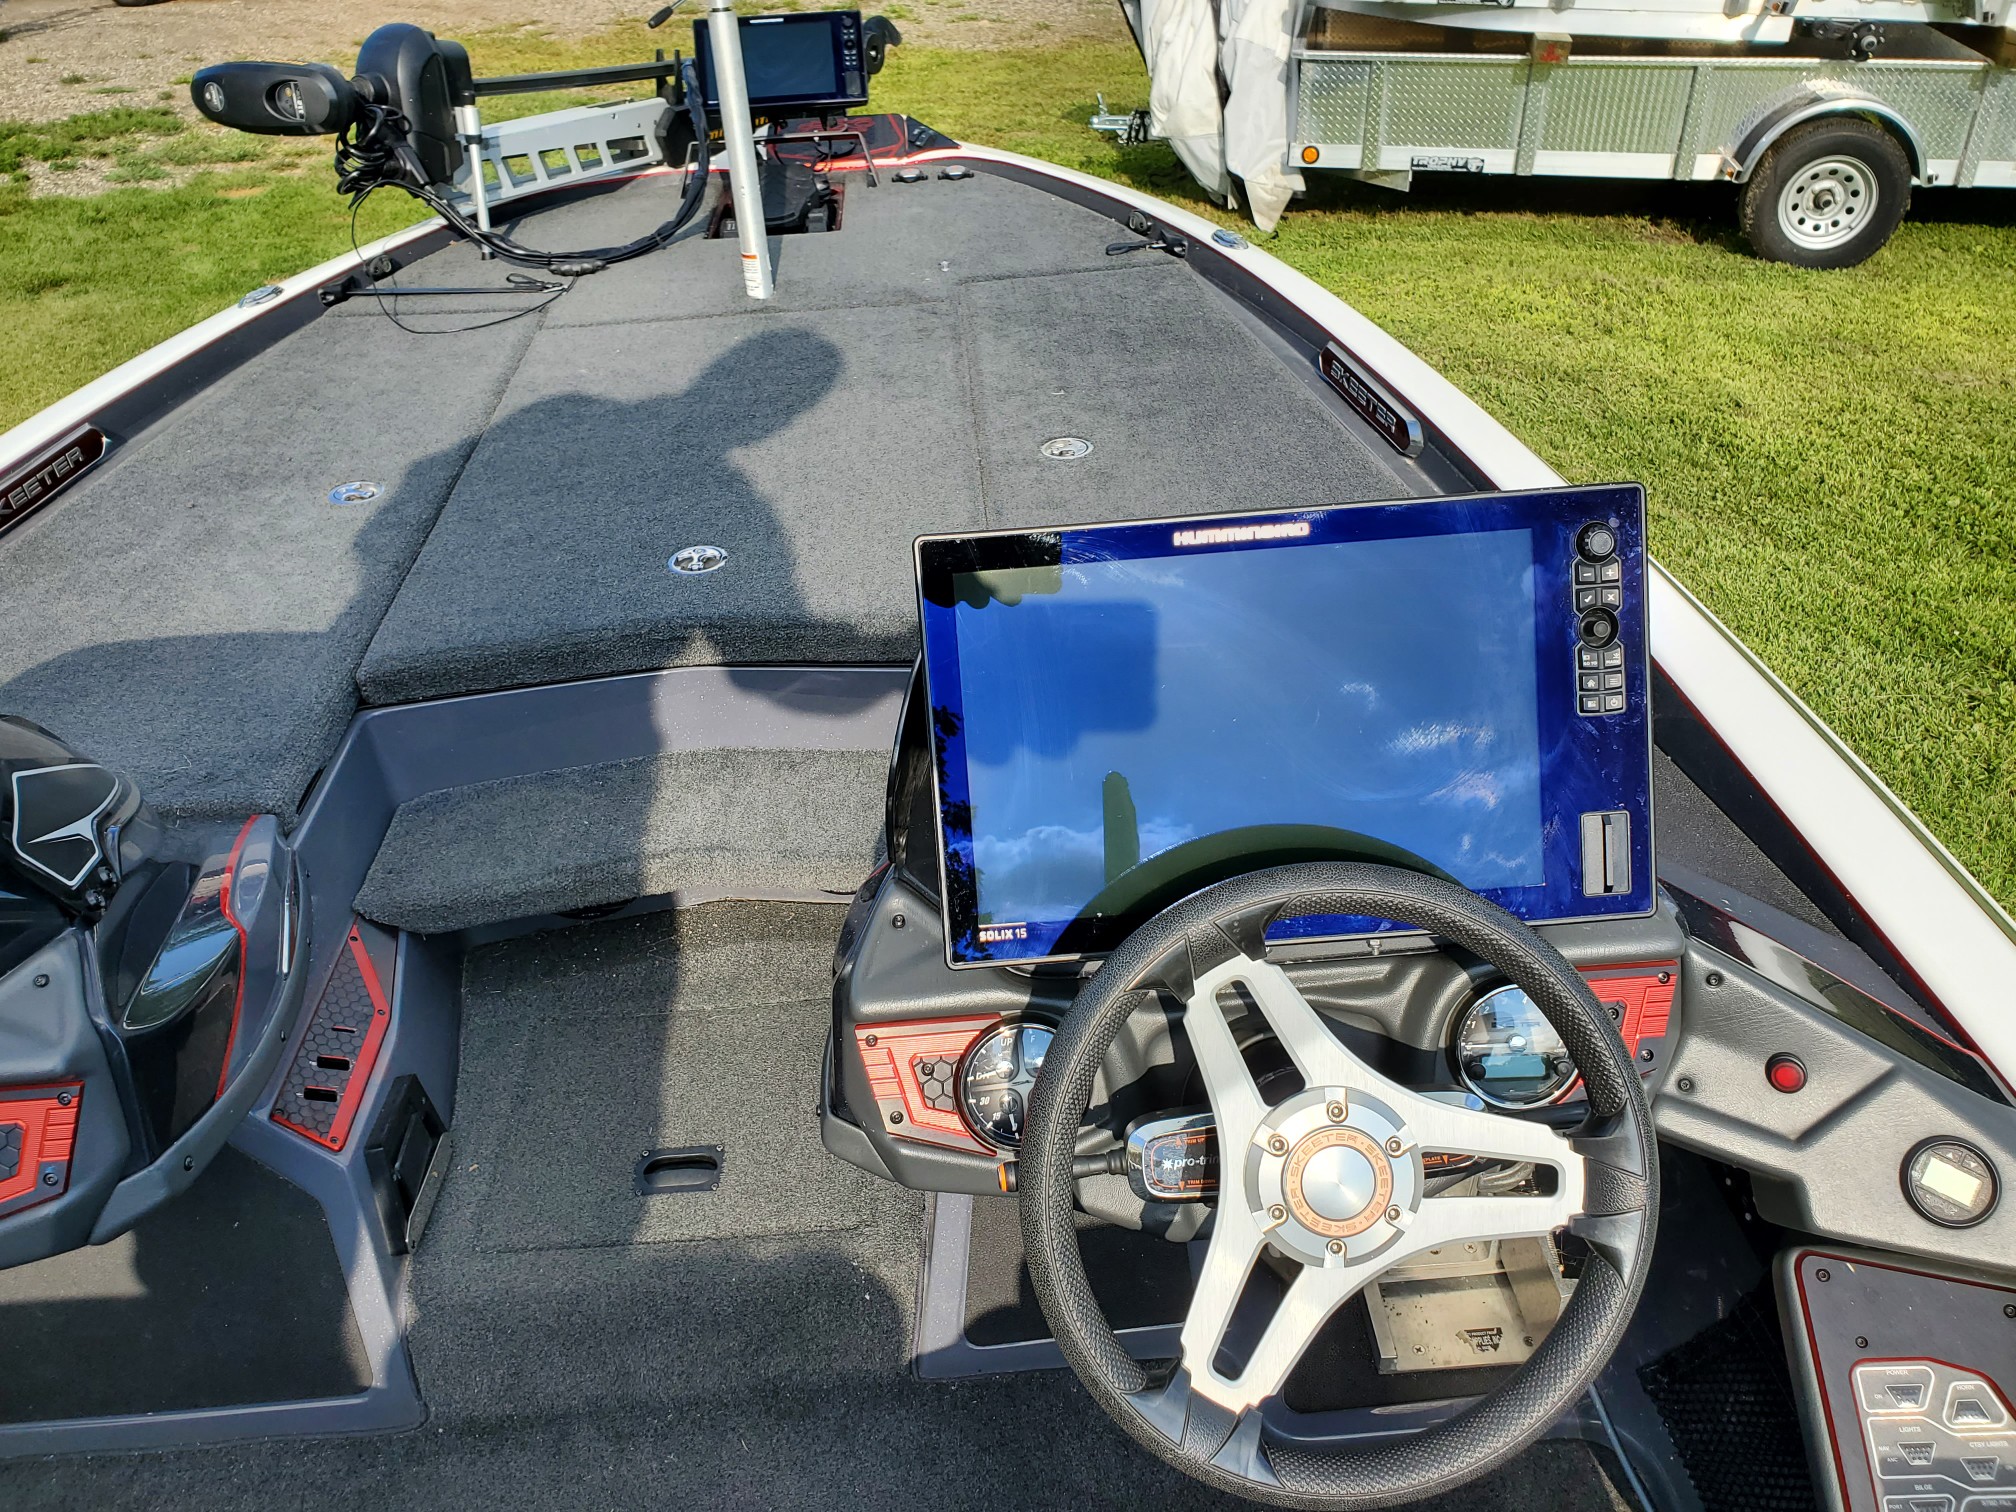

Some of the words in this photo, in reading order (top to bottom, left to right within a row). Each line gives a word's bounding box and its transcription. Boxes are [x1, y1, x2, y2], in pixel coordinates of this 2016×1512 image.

[1330, 360, 1397, 434] SKEETER
[979, 929, 1014, 943] SOLIX
[1015, 927, 1027, 939] 15
[1001, 1037, 1013, 1047] UP
[980, 1096, 990, 1106] 30
[992, 1111, 1001, 1121] 15
[1290, 1132, 1359, 1178] SKEETER
[1364, 1143, 1390, 1222] SKEETER
[1290, 1187, 1358, 1233] SKEETER
